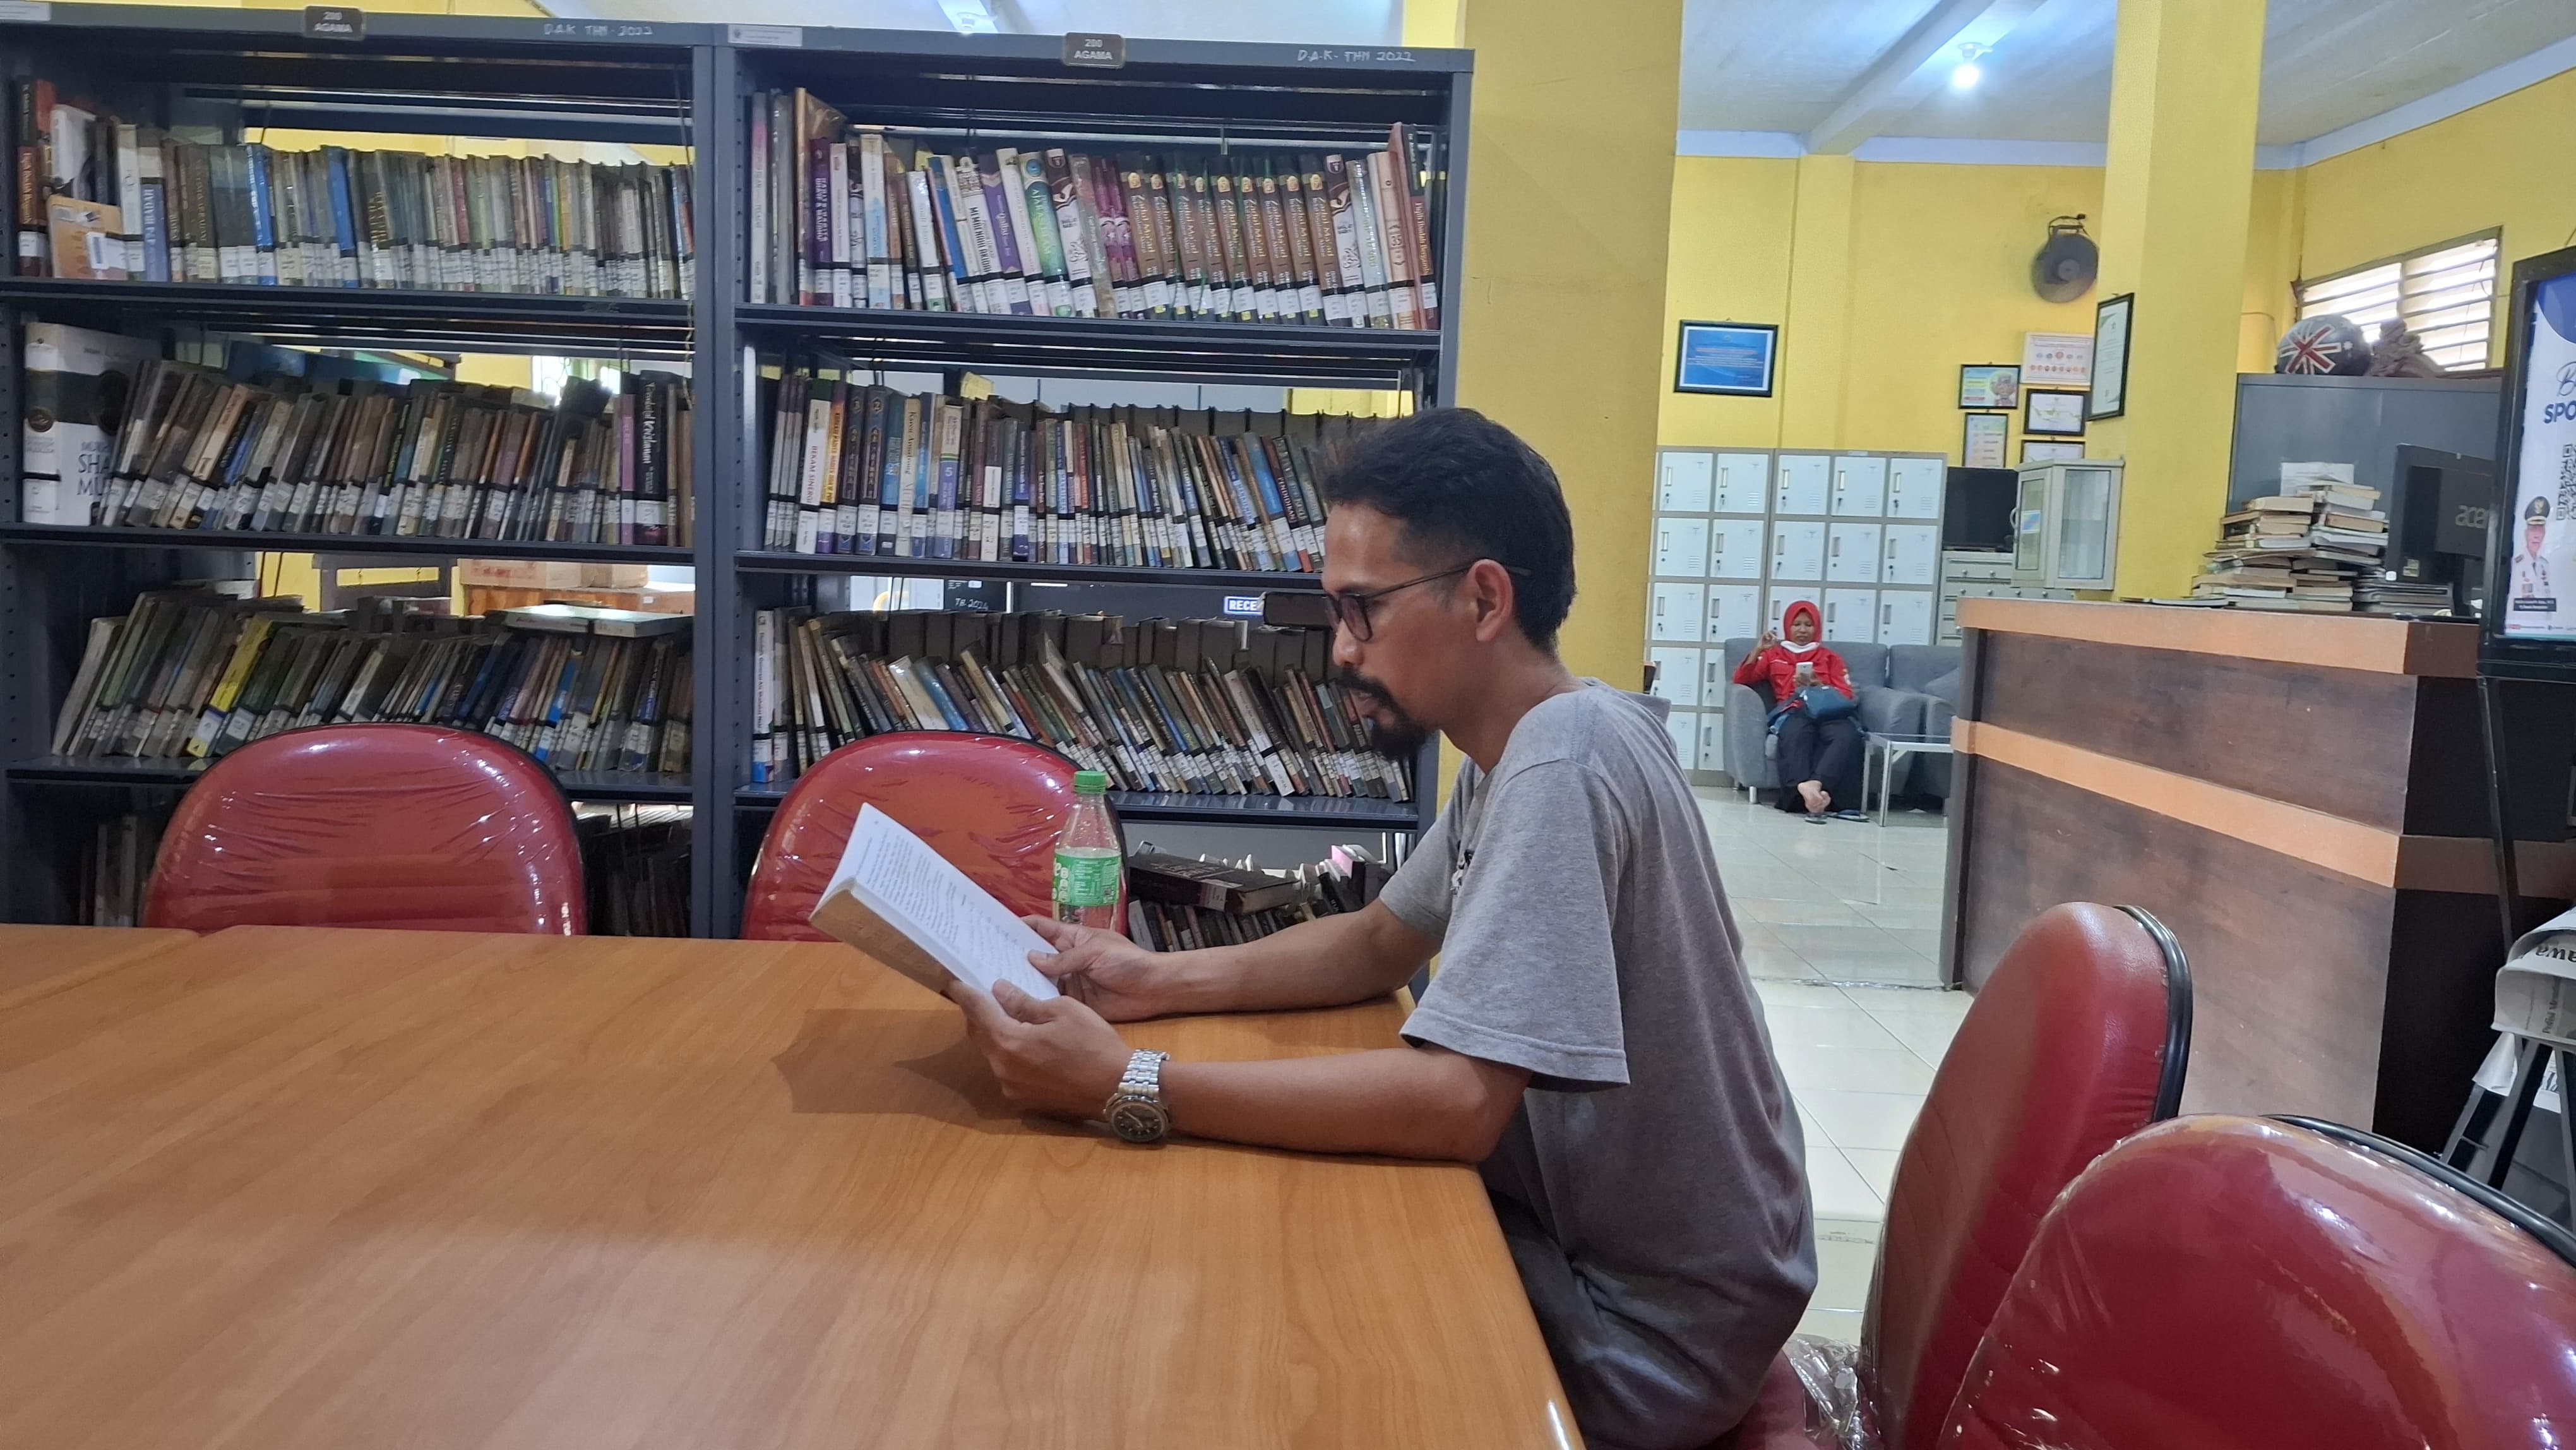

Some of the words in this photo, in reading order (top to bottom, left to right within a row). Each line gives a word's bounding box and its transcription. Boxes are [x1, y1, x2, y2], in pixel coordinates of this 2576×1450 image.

[1074, 51, 1113, 60] AGAMA
[1376, 51, 1417, 63] 2022
[2543, 400, 2576, 424] SPO
[1229, 599, 1258, 611] RECE
